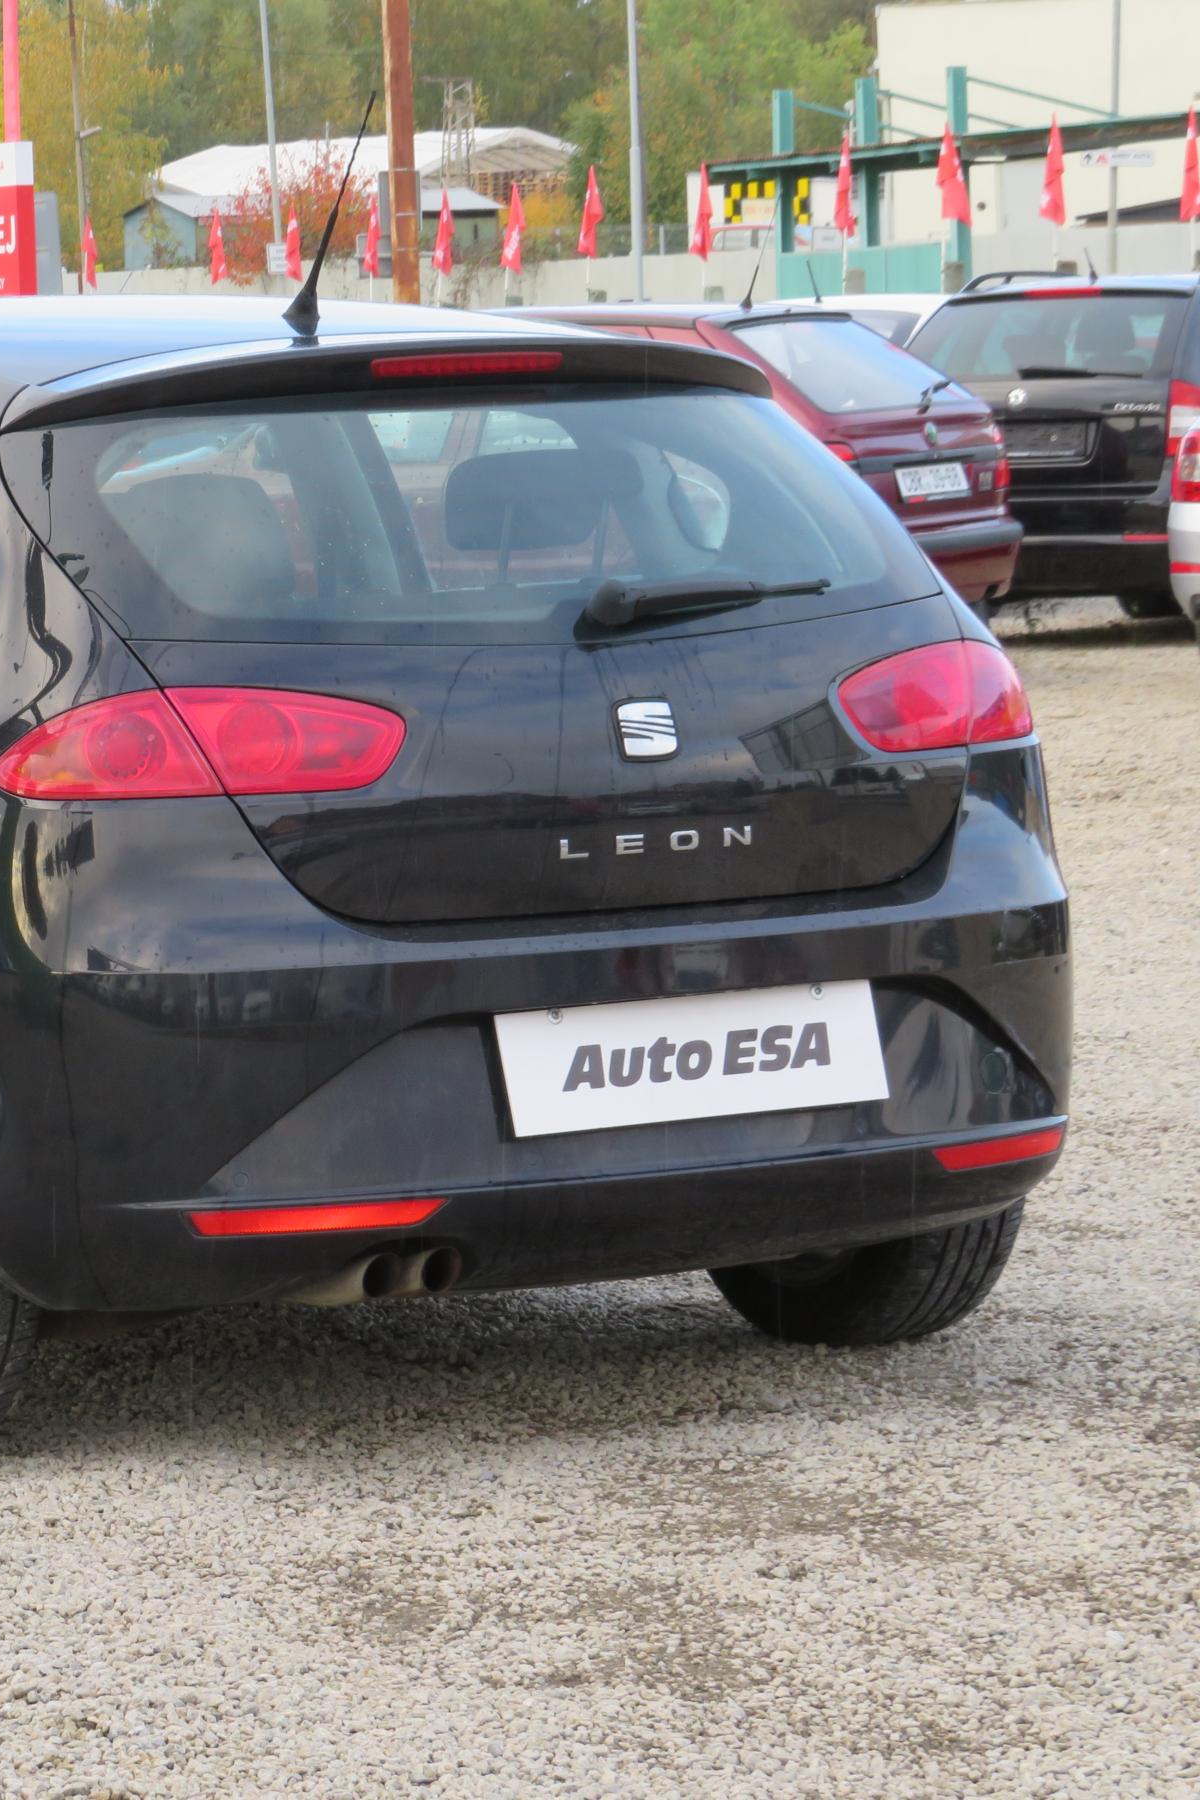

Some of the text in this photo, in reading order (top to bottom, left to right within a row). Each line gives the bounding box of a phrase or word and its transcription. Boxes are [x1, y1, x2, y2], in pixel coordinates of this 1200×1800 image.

[559, 825, 752, 860] LEON
[562, 1021, 831, 1092] Auto ESA
